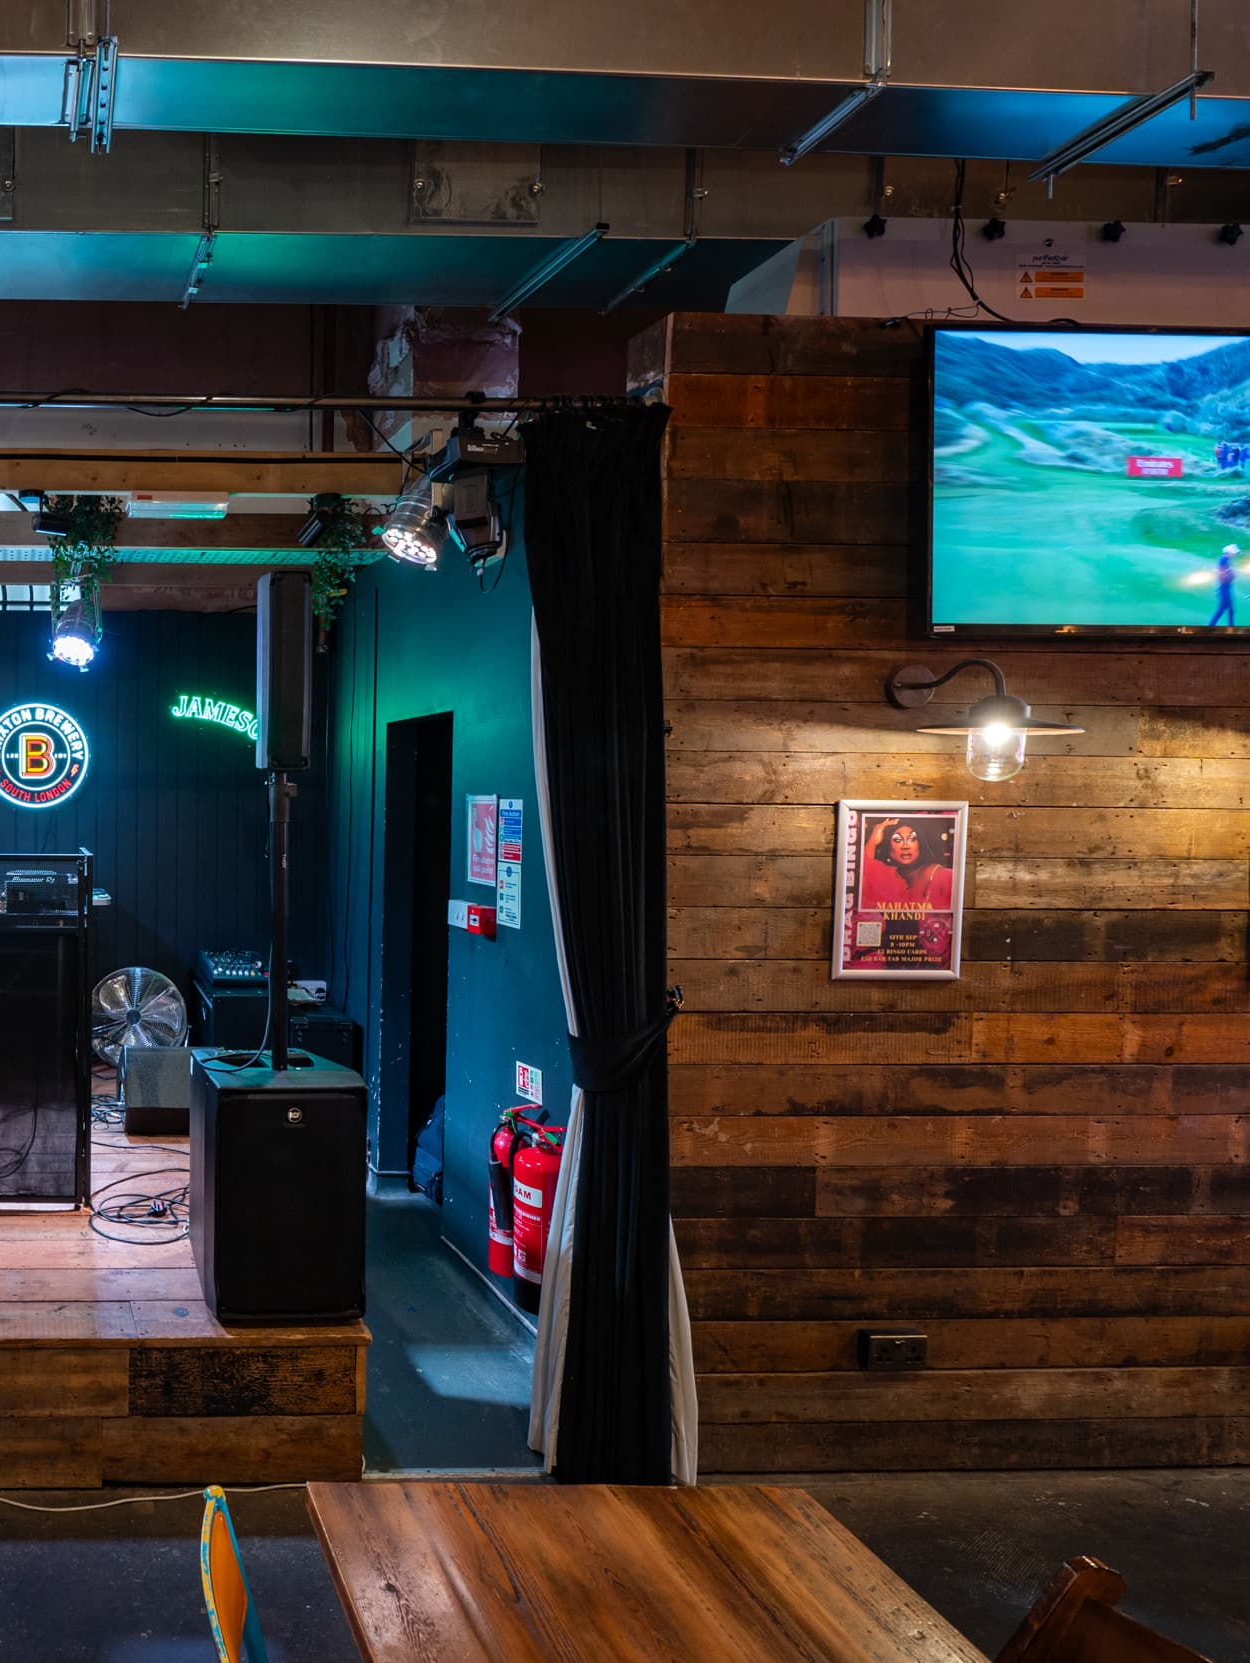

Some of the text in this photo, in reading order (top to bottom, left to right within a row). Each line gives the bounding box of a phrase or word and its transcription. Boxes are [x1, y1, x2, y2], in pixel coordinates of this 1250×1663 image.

[35, 707, 84, 760] BREWERY
[19, 732, 56, 779] B
[0, 778, 72, 803] SOUTH LONDON
[876, 901, 934, 911] MAHATMA
[883, 912, 926, 921] KHANDI
[514, 1184, 532, 1200] OAM
